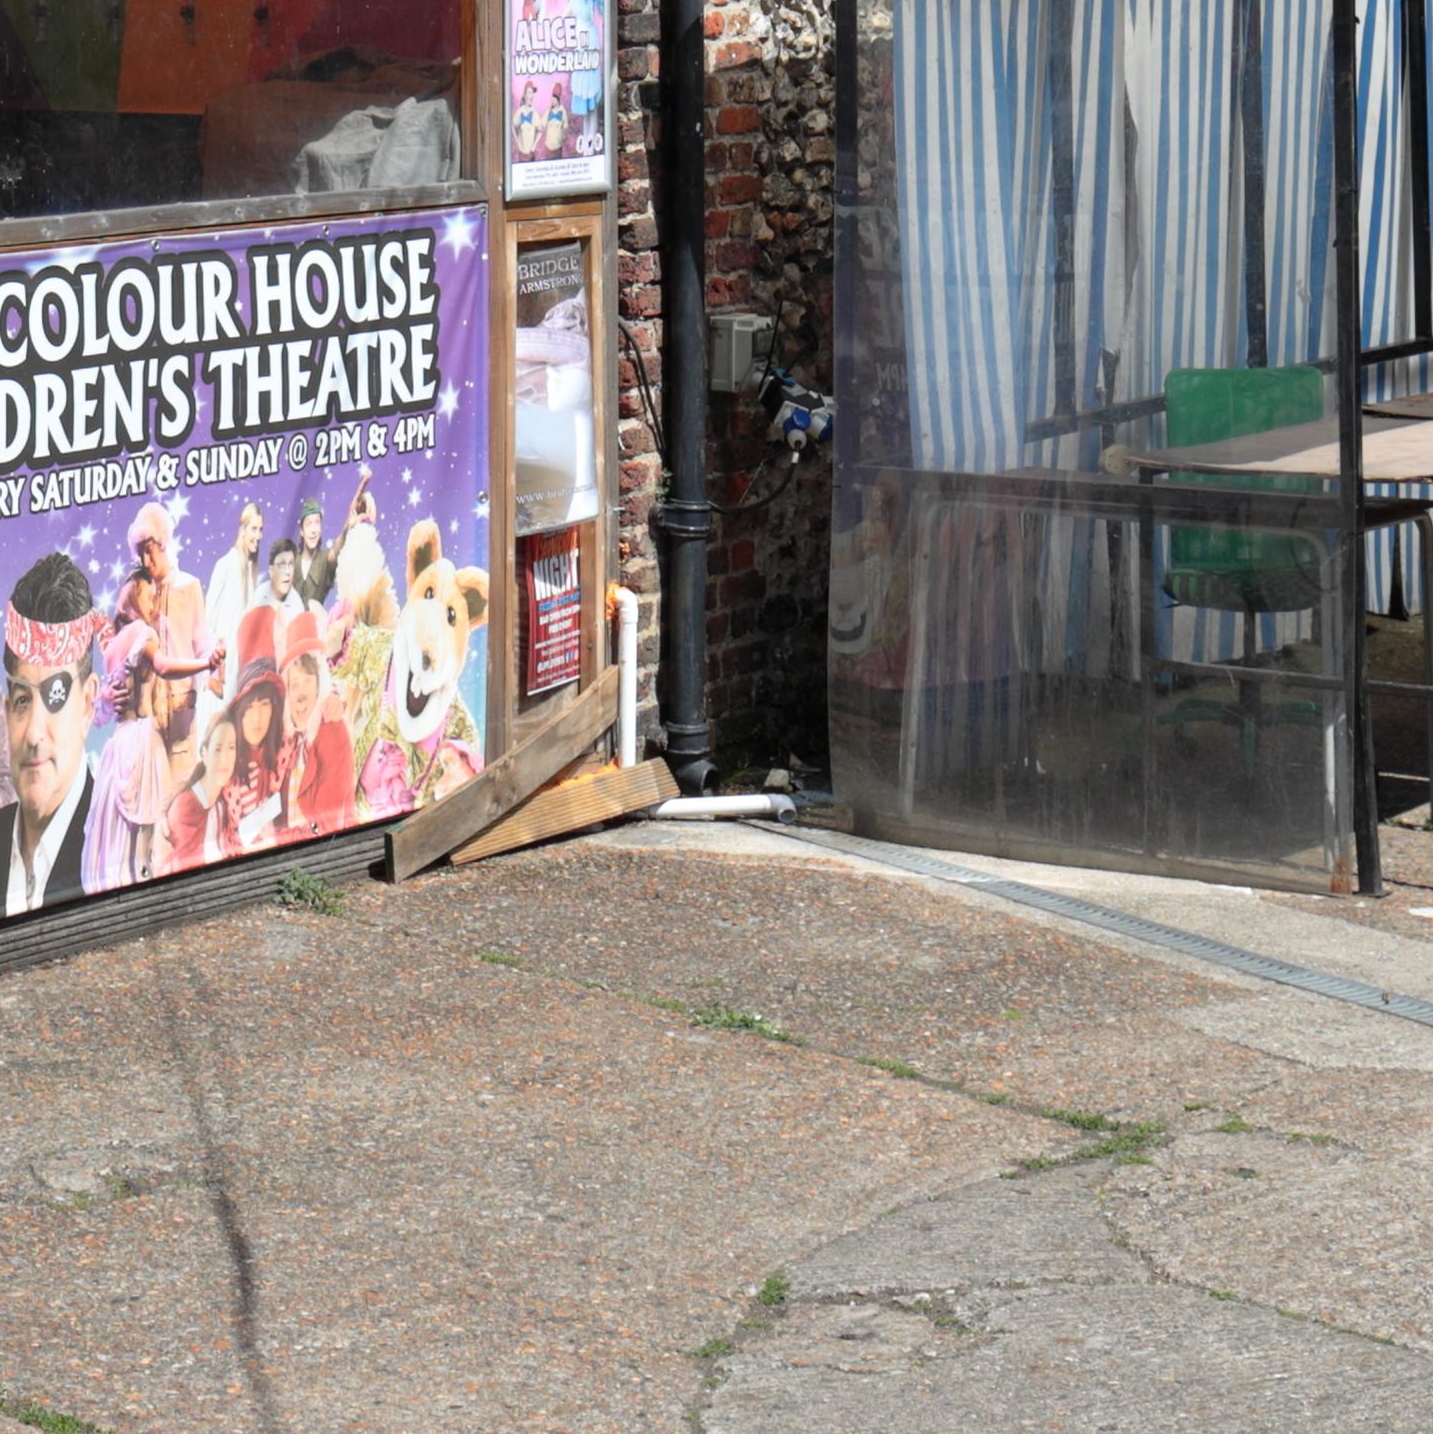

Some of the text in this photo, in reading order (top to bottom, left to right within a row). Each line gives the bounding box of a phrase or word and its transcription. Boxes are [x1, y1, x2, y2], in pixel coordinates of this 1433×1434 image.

[515, 49, 599, 74] WONDERLAND
[516, 16, 578, 52] ALICE
[254, 237, 435, 331] HOUSE
[210, 323, 436, 430] THEATRE
[30, 455, 152, 514] SATURDAY
[154, 458, 179, 488] &
[184, 439, 284, 485] SUNDAY
[314, 430, 364, 468] 2PM
[393, 415, 436, 452] 4PM
[534, 548, 580, 602] NIGHT
